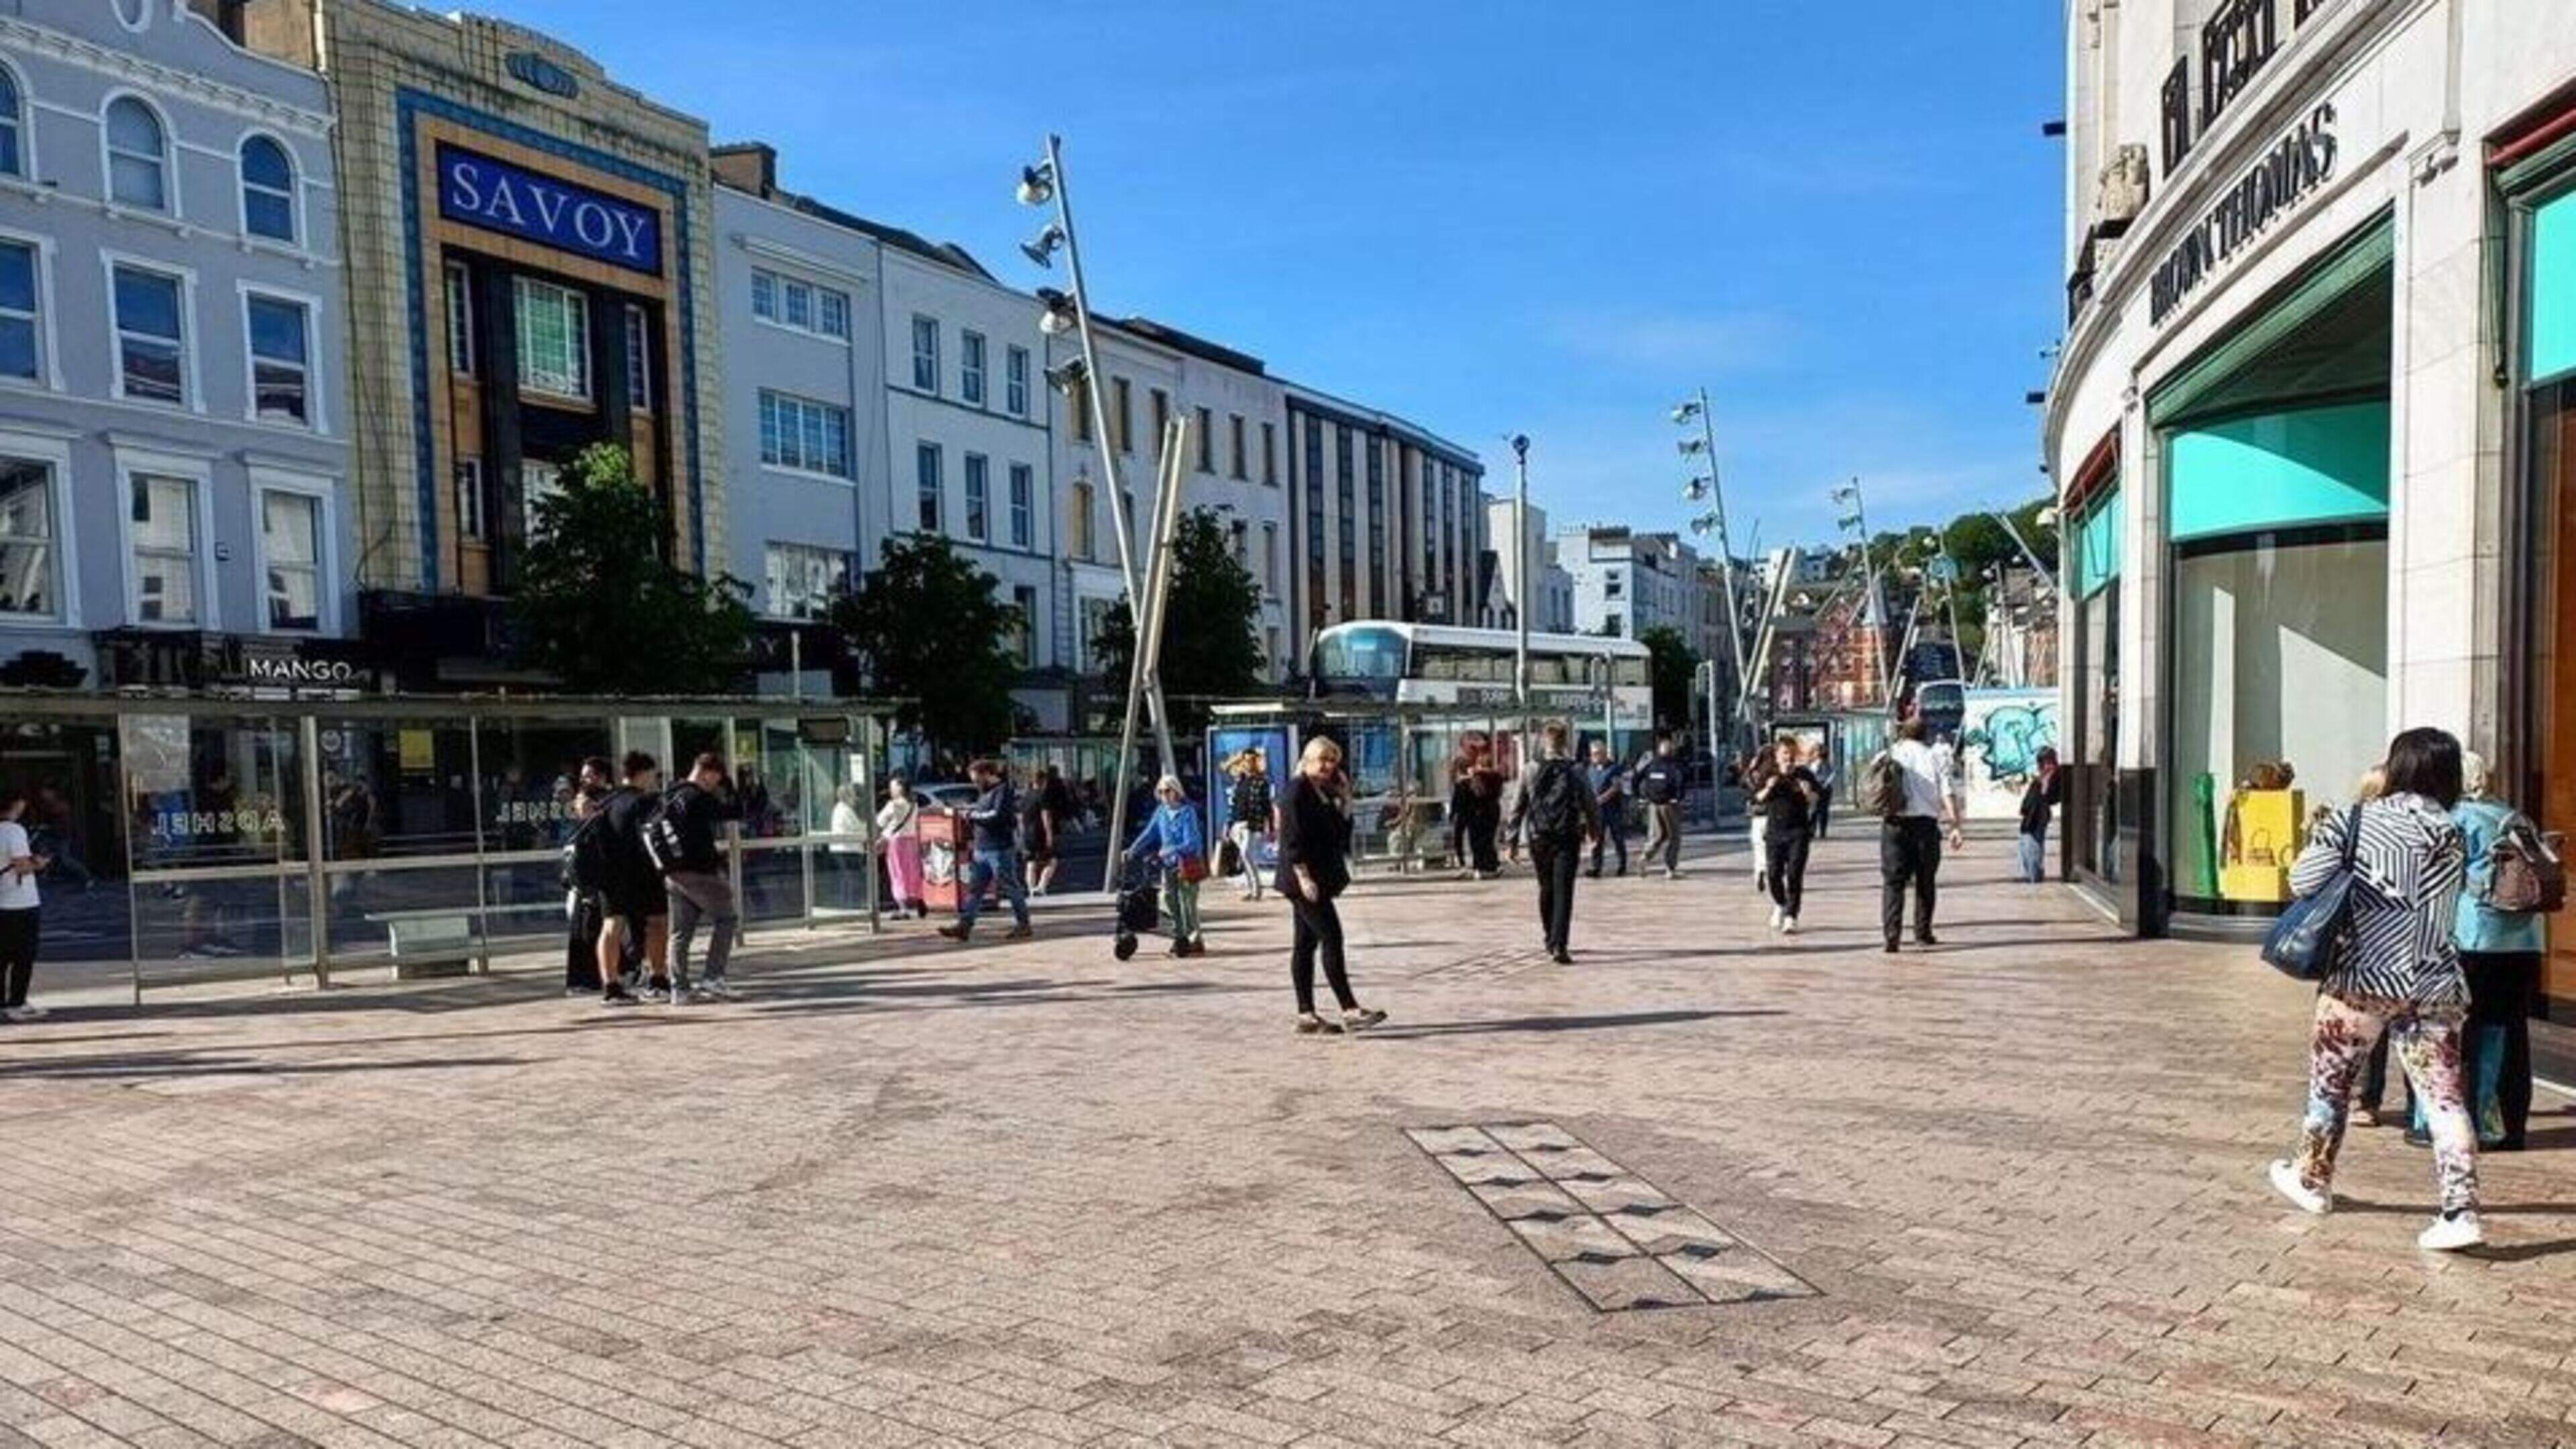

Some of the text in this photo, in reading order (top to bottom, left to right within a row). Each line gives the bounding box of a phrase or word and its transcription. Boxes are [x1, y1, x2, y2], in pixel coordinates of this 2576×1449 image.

[452, 163, 644, 258] SAVOY
[2215, 101, 2337, 261] THOMAS
[249, 659, 352, 680] MANGO
